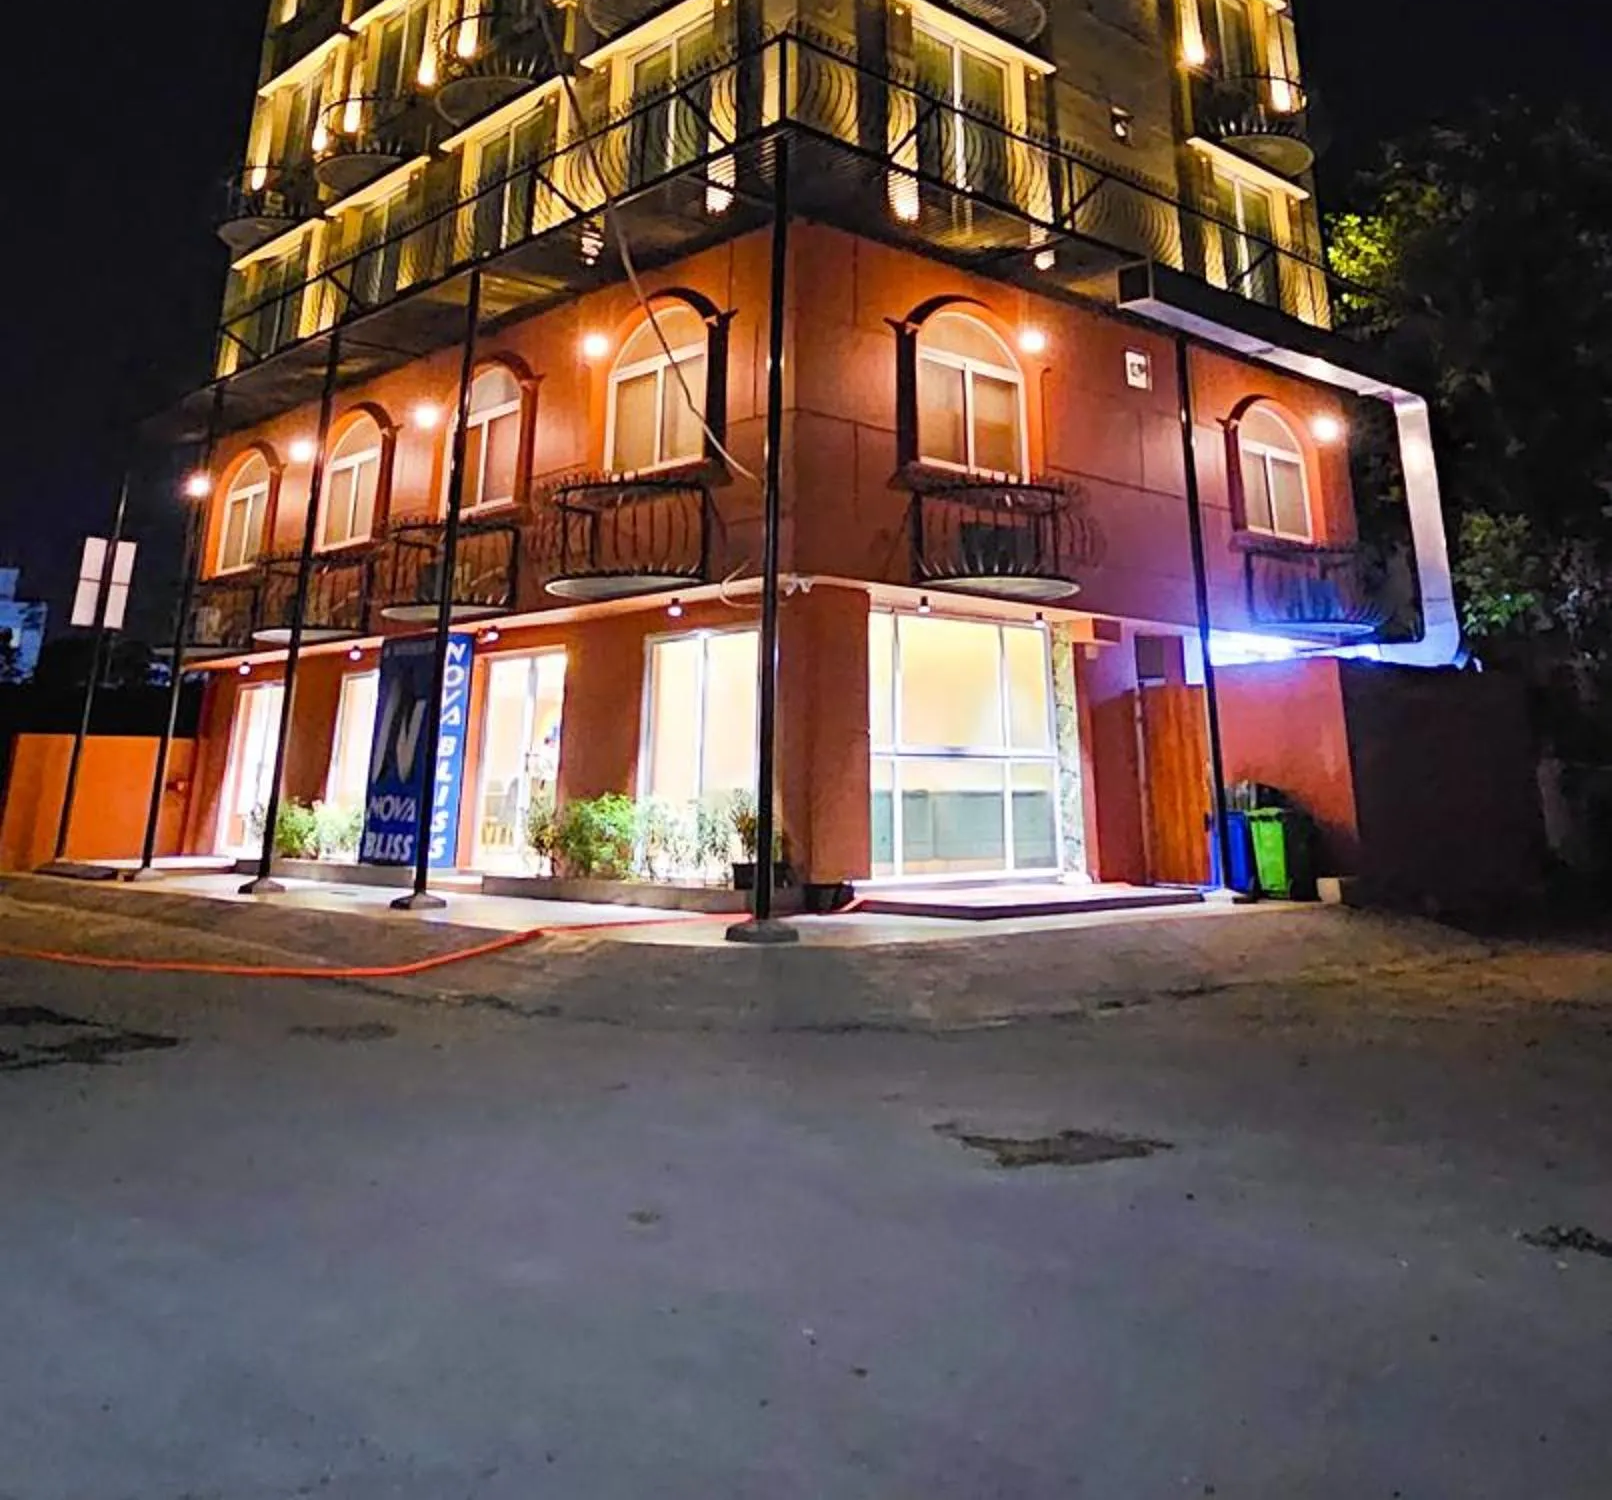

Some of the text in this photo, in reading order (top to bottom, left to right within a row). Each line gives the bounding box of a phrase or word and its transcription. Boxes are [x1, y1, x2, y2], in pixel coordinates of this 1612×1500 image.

[429, 642, 467, 859] NOVA BLISS
[366, 794, 416, 822] NOVA
[362, 832, 415, 861] BLISS
